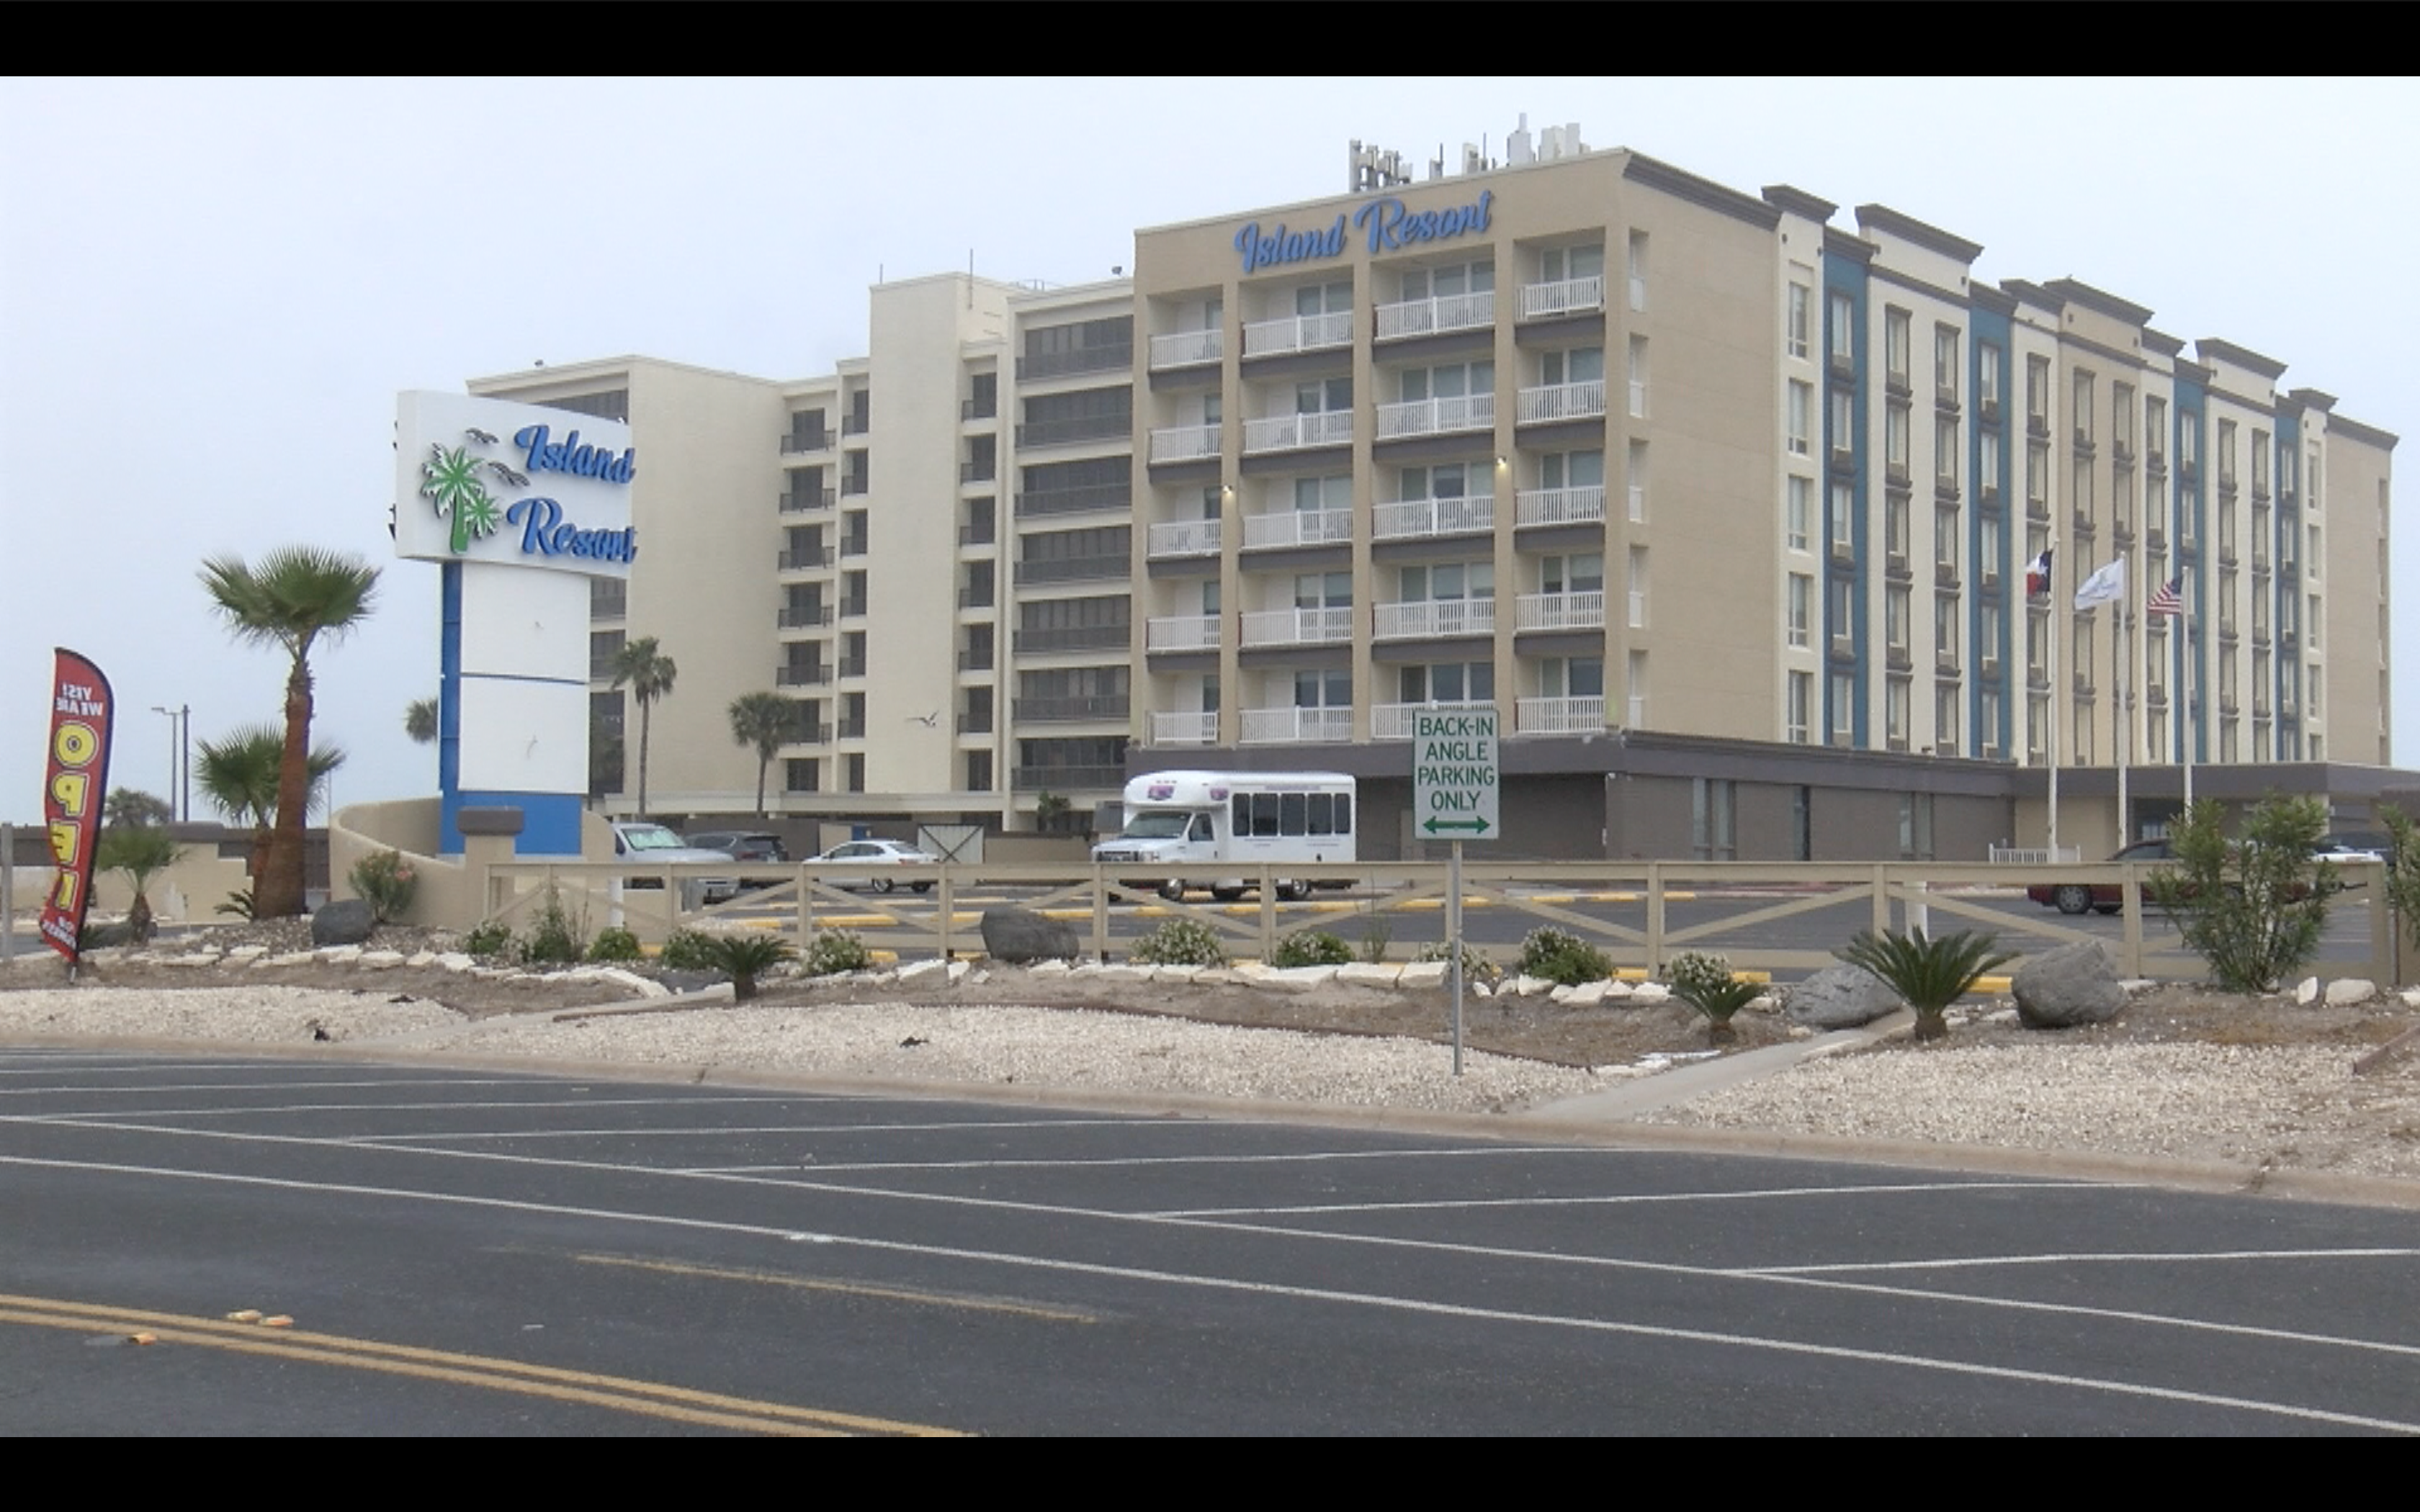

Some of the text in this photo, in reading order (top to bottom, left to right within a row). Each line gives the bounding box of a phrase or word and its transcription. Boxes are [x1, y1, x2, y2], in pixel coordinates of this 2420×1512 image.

[1234, 189, 1494, 274] Island Resort
[513, 424, 637, 485] Island
[506, 497, 638, 564] Resort
[1420, 717, 1494, 737] BACK-IN
[1425, 741, 1489, 761] ANGLE
[1417, 765, 1494, 786] PARKING
[1430, 790, 1481, 811] ONLY
